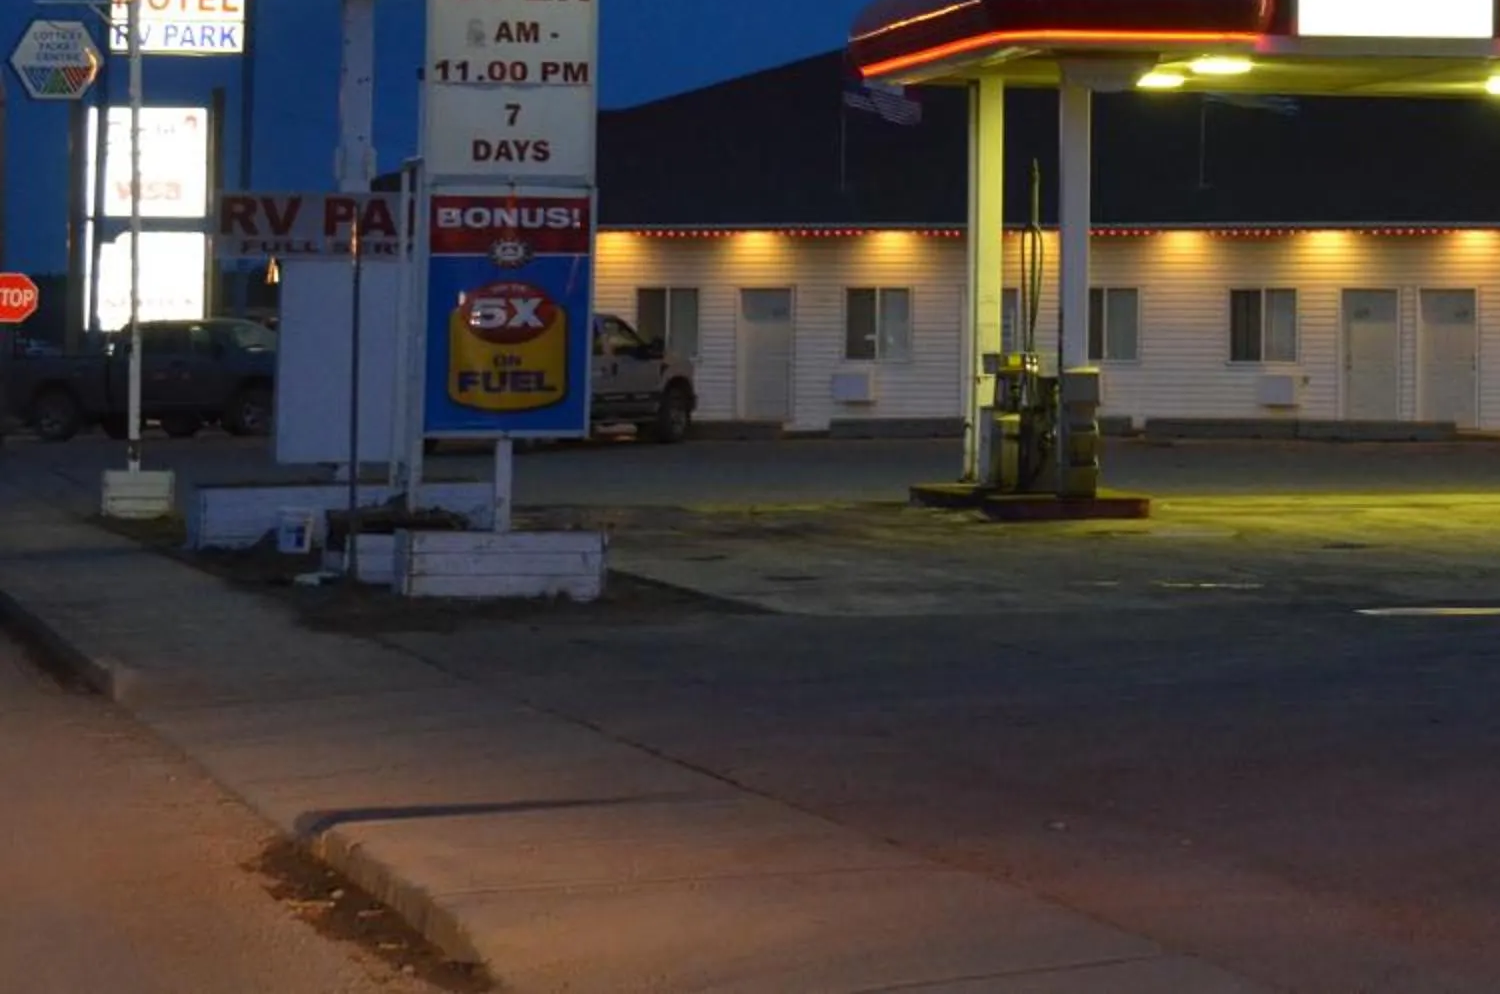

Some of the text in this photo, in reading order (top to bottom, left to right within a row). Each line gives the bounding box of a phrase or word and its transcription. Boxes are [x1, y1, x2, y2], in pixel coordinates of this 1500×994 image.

[163, 25, 237, 47] PARK
[495, 21, 540, 43] AM
[436, 60, 588, 82] 11.00 PM
[504, 104, 521, 126] 7
[473, 140, 550, 162] DAYS
[221, 197, 415, 236] RV PA
[438, 208, 581, 228] BONUS!
[471, 298, 544, 328] 5X
[459, 371, 557, 394] FUEL
